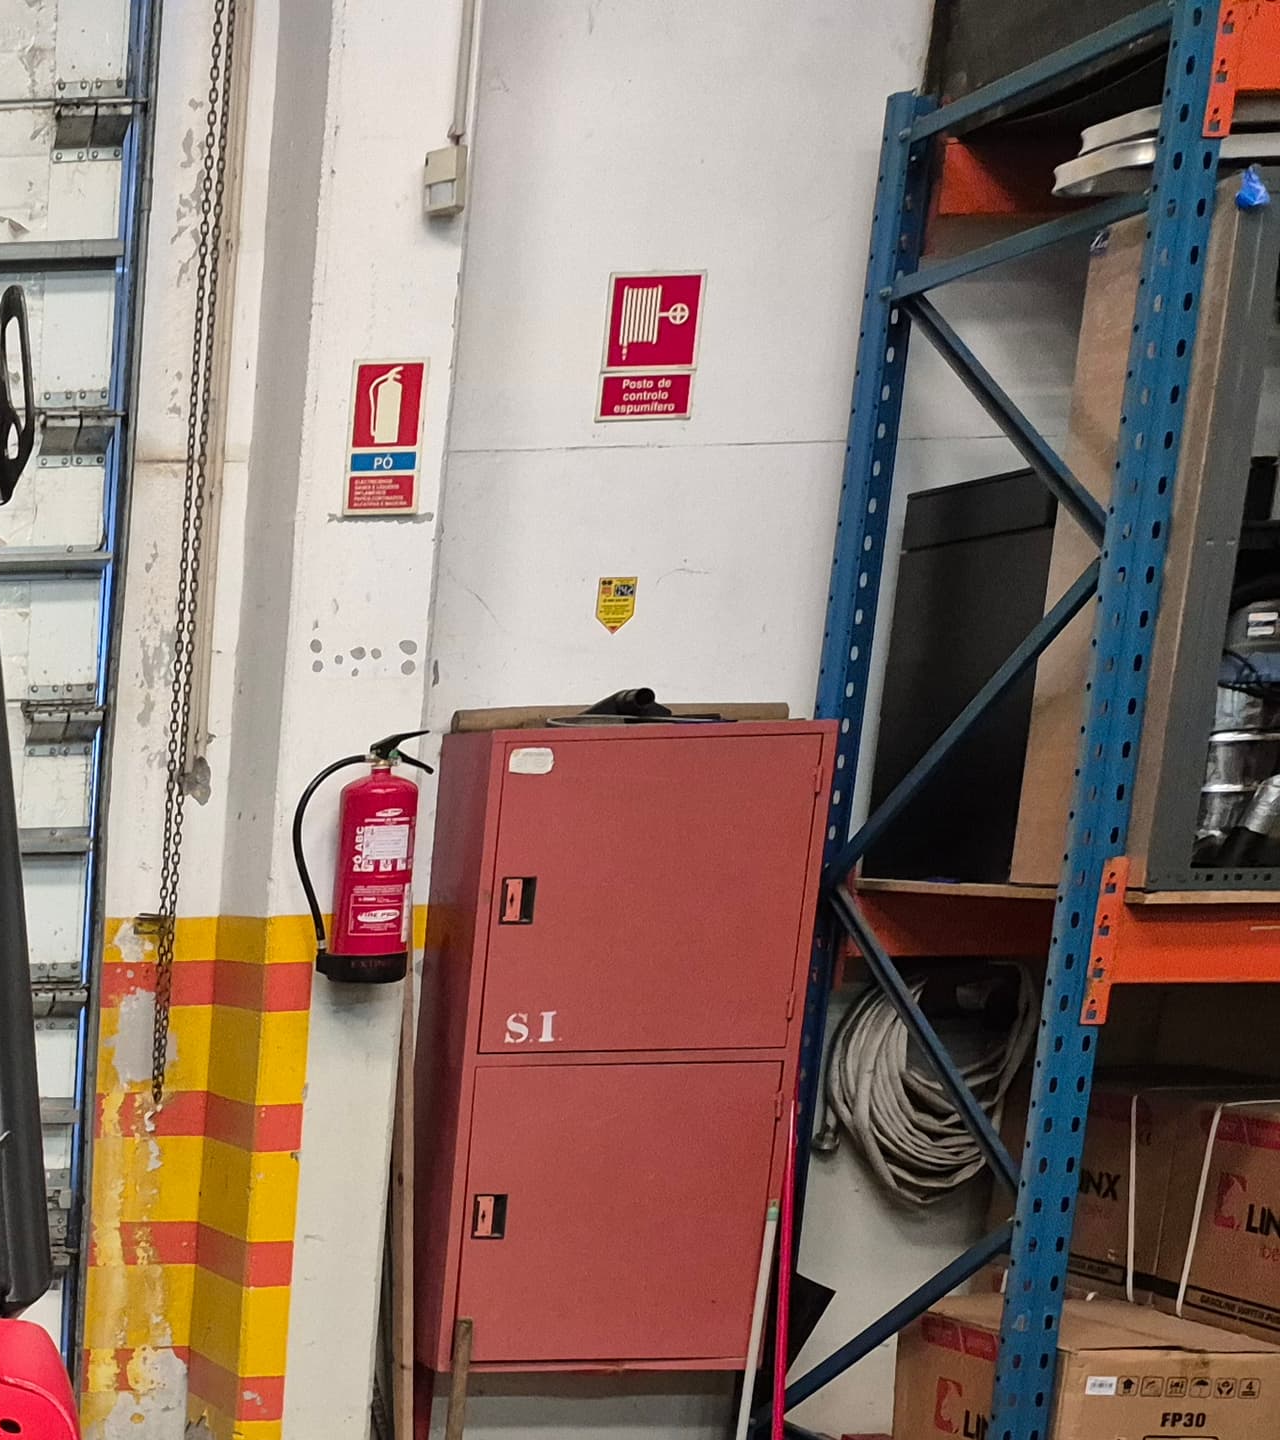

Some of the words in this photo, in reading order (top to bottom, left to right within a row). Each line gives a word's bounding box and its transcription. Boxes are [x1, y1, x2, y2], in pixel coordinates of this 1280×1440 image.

[622, 378, 654, 390] Posto
[658, 377, 672, 389] de
[623, 390, 669, 402] controlo
[373, 454, 394, 470] PÓ
[354, 826, 365, 851] ABC
[1078, 1167, 1121, 1201] INX
[1245, 1203, 1280, 1239] LIN
[1160, 1412, 1207, 1428] FP30
